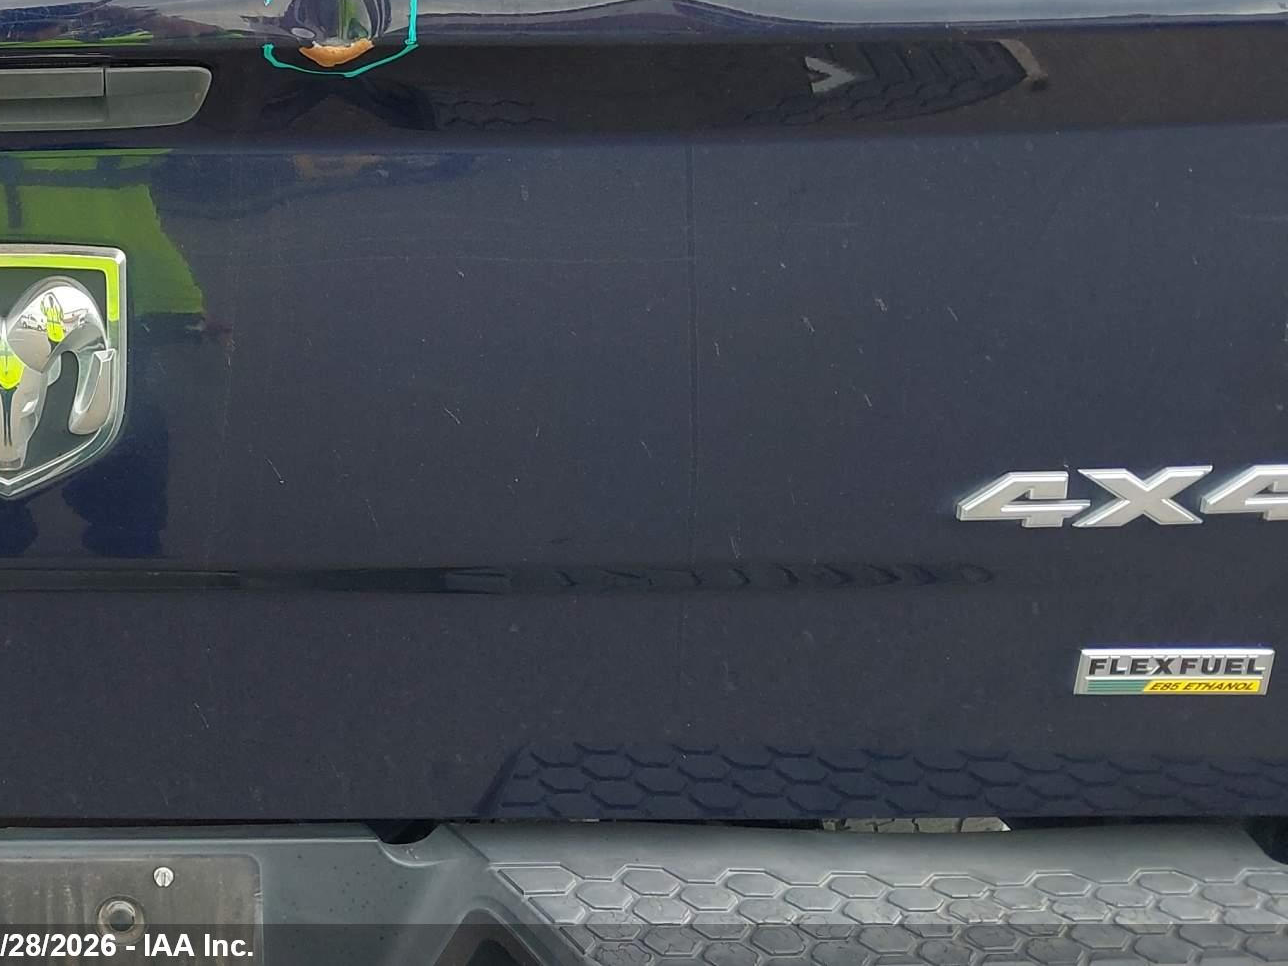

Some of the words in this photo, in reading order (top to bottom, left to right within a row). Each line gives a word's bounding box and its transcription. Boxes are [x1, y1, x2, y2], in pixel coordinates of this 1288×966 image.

[1088, 656, 1264, 676] FLEXFUEL
[1150, 682, 1180, 692] E85
[1182, 682, 1254, 692] ETHANOL
